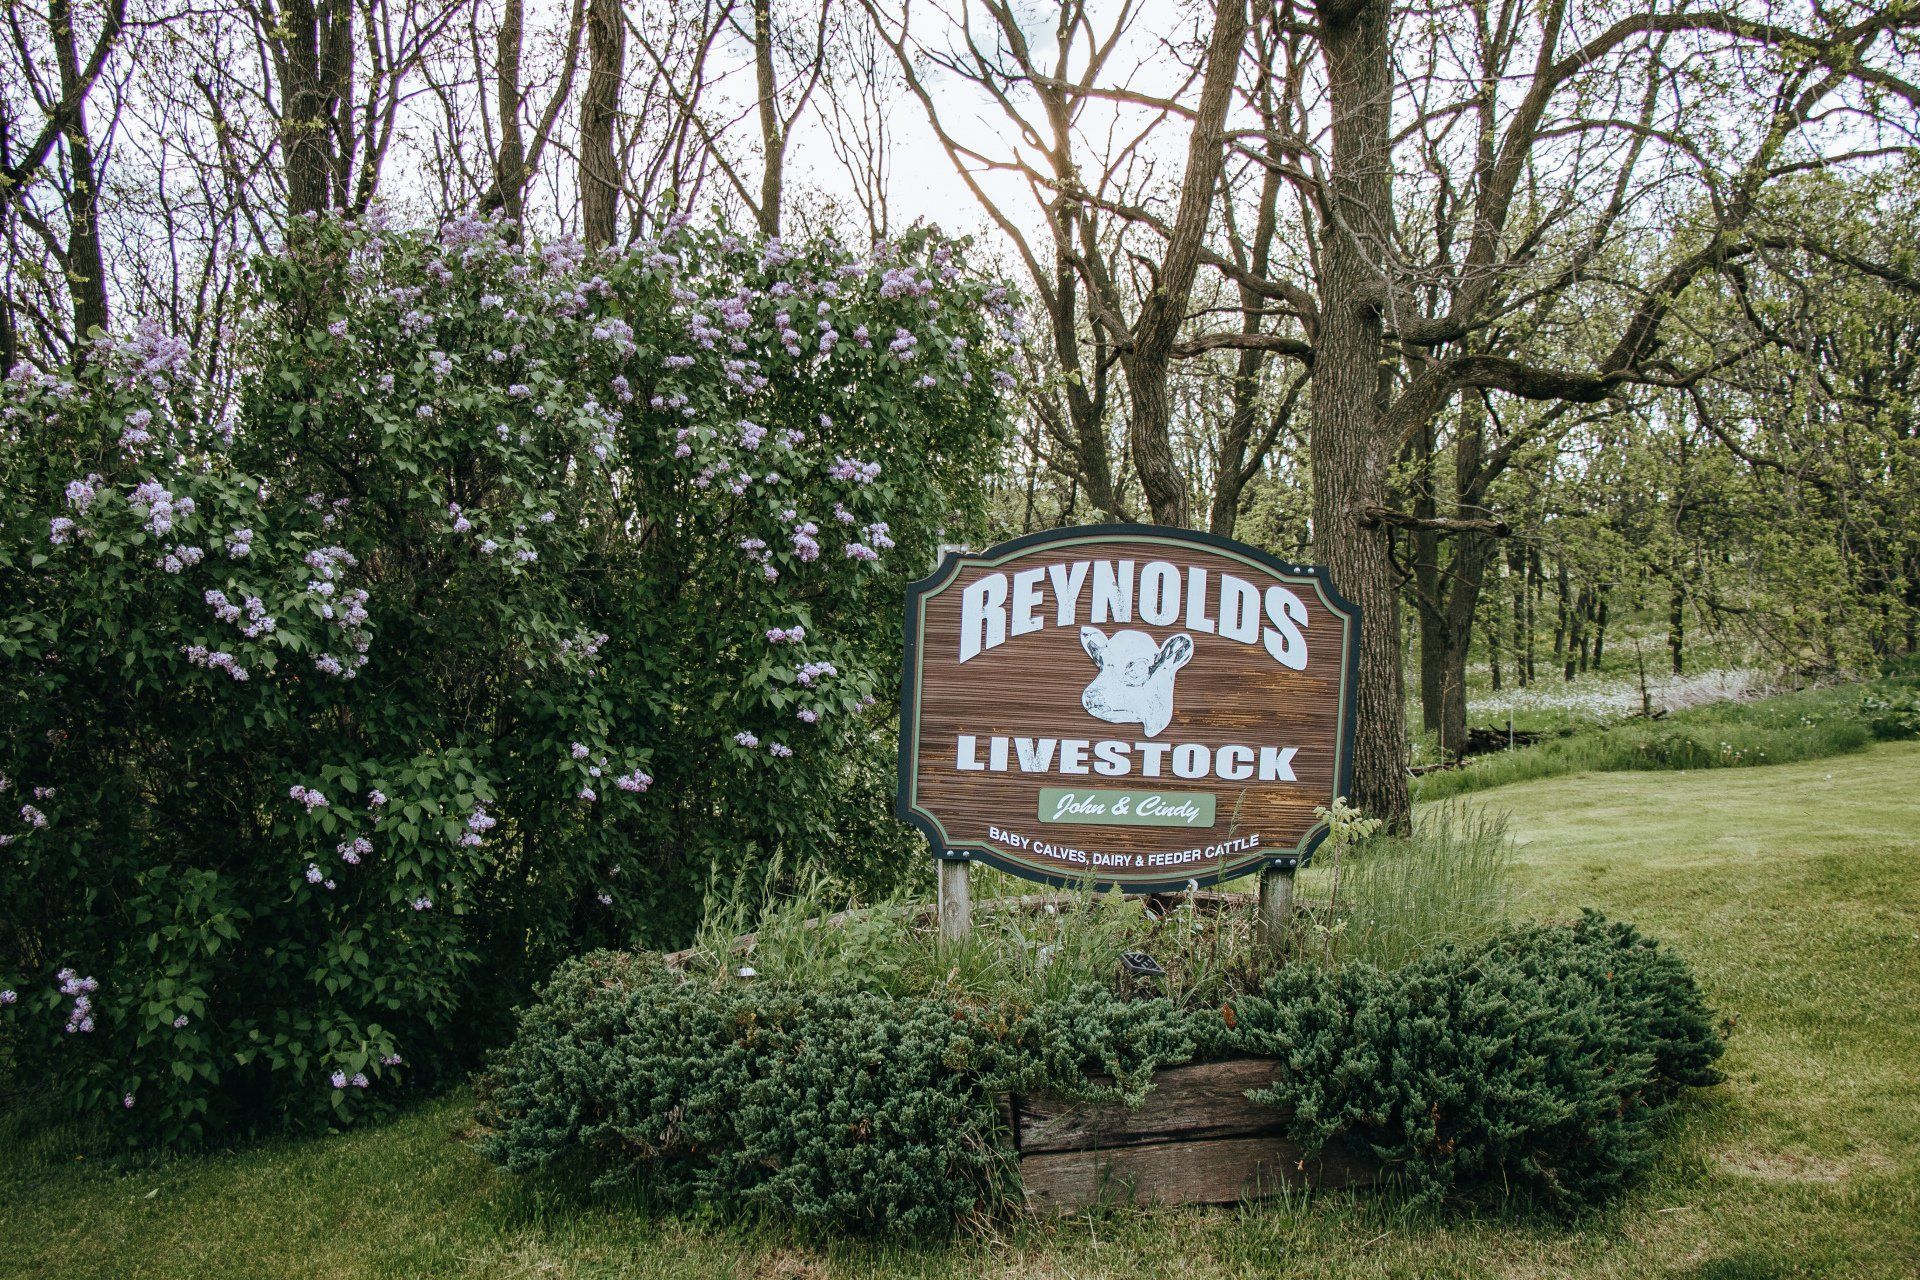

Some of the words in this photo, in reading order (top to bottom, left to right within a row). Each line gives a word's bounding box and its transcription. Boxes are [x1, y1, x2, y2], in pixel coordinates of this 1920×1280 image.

[959, 560, 1309, 670] REYNOLDS
[956, 735, 1299, 782] LIVESTOCK
[1053, 793, 1106, 820] John
[1111, 796, 1130, 816] &
[1136, 795, 1200, 823] Cindy
[989, 826, 1030, 850] BABY
[1033, 840, 1090, 866] CALVES,
[1092, 853, 1132, 867] DAIRY
[1135, 853, 1144, 867] &
[1148, 849, 1201, 866] FEEDER
[1204, 833, 1260, 859] CATTLE
